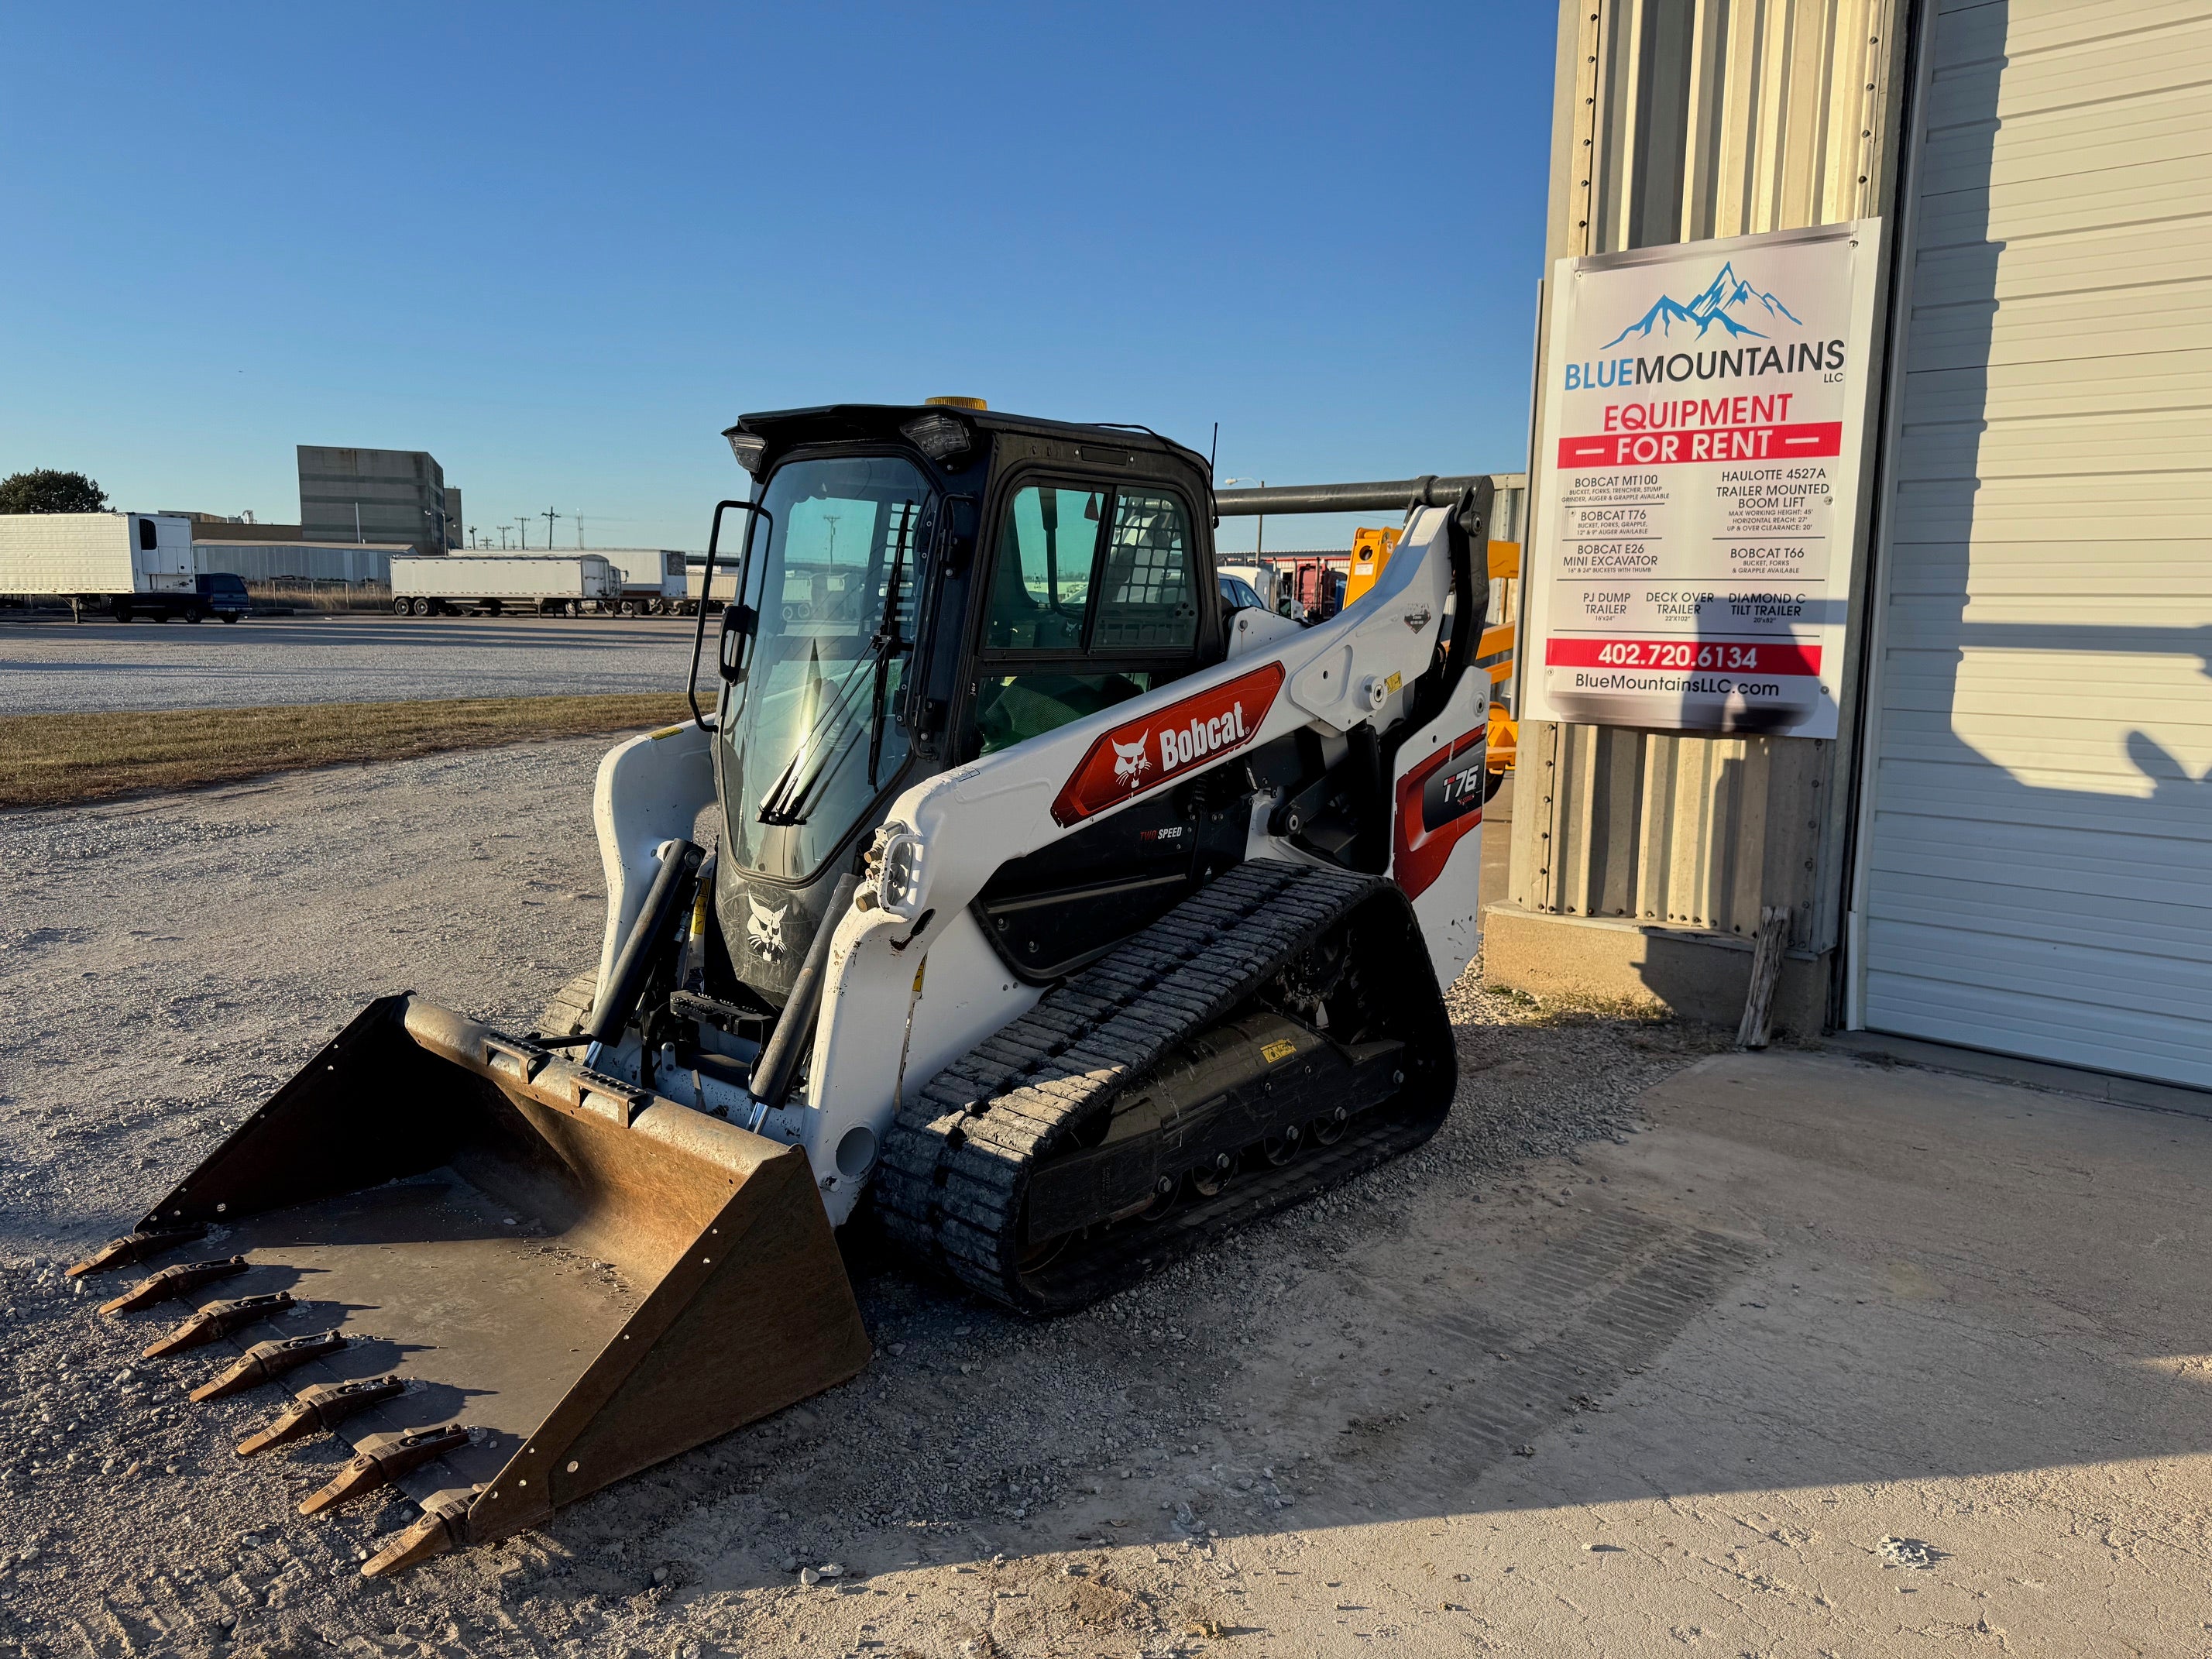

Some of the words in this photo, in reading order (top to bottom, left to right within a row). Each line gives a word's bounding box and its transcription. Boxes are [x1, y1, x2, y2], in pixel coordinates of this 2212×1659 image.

[1565, 339, 1845, 390] BLUEMOUNTAINS
[1823, 373, 1843, 383] LLC
[1603, 393, 1793, 432] EQUIPMENT
[1616, 437, 1679, 464] FOR
[1692, 430, 1774, 460] RENT
[1575, 476, 1620, 488] BOBCAT
[1622, 475, 1657, 486] MT100
[1721, 469, 1782, 482] HAULOTTE
[1786, 468, 1826, 479] 4527A
[1716, 486, 1763, 497] TRAILER
[1766, 483, 1829, 496] MOUNTED
[1738, 497, 1779, 509] BOOM
[1783, 496, 1805, 508] LIFT
[1581, 510, 1625, 521] BOBCAT
[1628, 510, 1647, 520] T76
[1578, 544, 1622, 555] BOBCAT
[1625, 544, 1644, 554] E26
[1730, 548, 1781, 558] BOBCAT
[1784, 548, 1805, 558] T66
[1563, 556, 1588, 566] MINI
[1591, 555, 1657, 566] EXCAVATOR
[1583, 592, 1595, 603] PJ
[1598, 592, 1631, 603] DUMP
[1646, 592, 1678, 603] DECK
[1681, 592, 1714, 603] OVER
[1729, 593, 1791, 604] DIAMOND
[1796, 593, 1806, 603] C
[1585, 604, 1626, 614] TRAILER
[1657, 604, 1701, 614] TRAILER
[1731, 605, 1751, 616] TILT
[1754, 606, 1802, 617] TRAILER
[1598, 644, 1757, 668] 402.720.6134
[1575, 674, 1779, 696] BlueMountainsLLC.com
[1159, 701, 1245, 771] Bobcat
[1443, 764, 1479, 803] T76
[1158, 826, 1182, 840] SPEED
